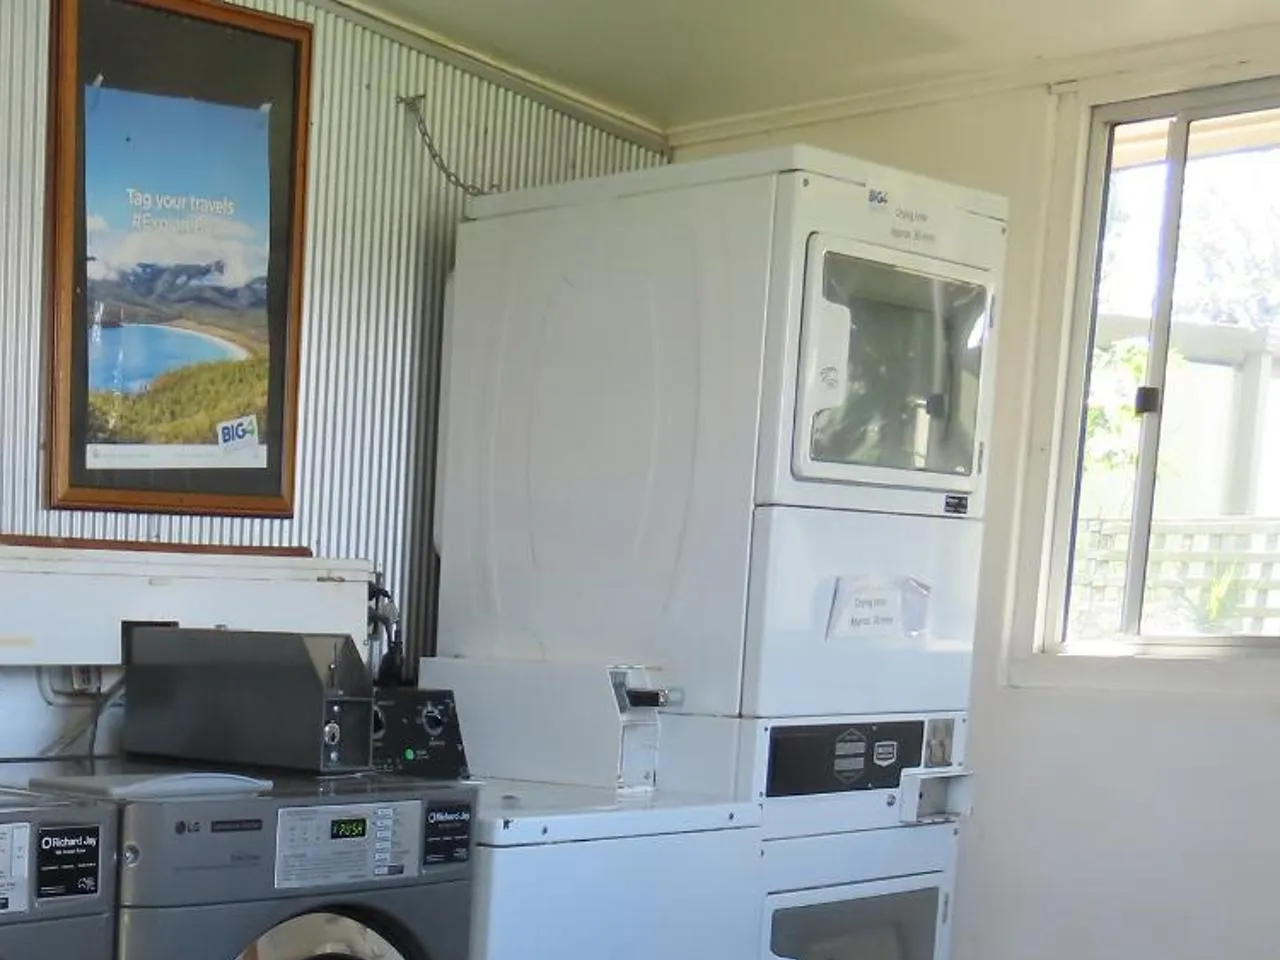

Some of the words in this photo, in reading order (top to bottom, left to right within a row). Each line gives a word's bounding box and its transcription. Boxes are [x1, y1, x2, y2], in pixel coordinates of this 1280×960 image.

[125, 187, 152, 209] Tag
[156, 192, 187, 210] your
[190, 195, 235, 216] travels
[221, 419, 256, 443] BIG4
[52, 835, 83, 848] Richard
[83, 835, 97, 847] Jay
